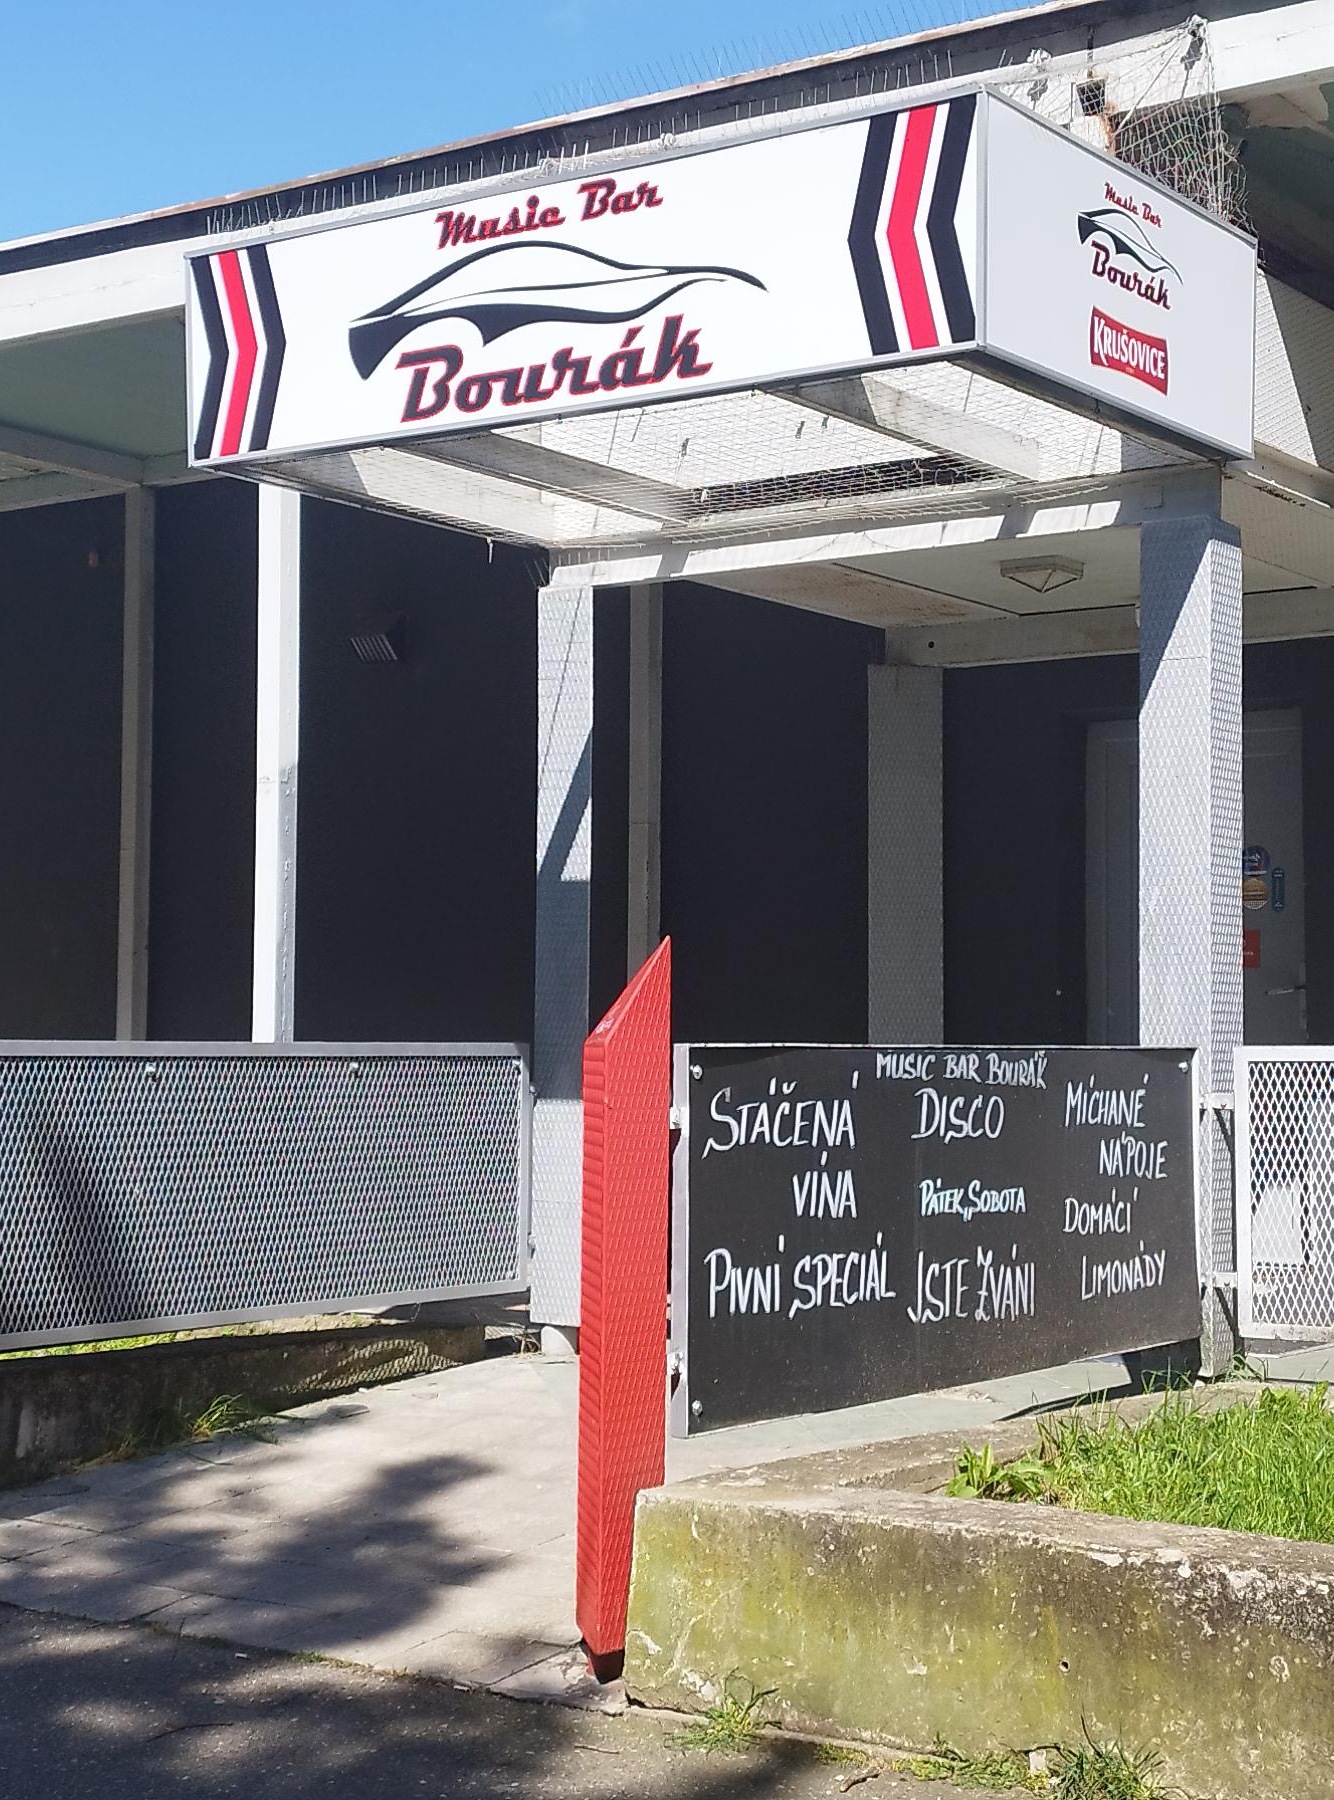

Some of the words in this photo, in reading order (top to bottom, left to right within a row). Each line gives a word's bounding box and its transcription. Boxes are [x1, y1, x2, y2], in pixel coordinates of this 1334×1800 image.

[434, 194, 566, 250] Music
[577, 177, 664, 221] Bar
[1104, 181, 1139, 216] Music
[1141, 202, 1163, 229] Bar
[1091, 239, 1172, 311] Bourák
[395, 313, 713, 423] Bourák
[876, 1052, 936, 1082] MUSIC
[942, 1053, 982, 1083] BAR
[1064, 1072, 1150, 1128] MÍCHANÉ
[701, 1069, 860, 1160] STÁČENÁ
[910, 1087, 1005, 1145] DISCO
[792, 1150, 858, 1220] VÍNA
[1098, 1130, 1169, 1180] NÁPOJE
[1062, 1186, 1139, 1236] DOMÁCÍ
[703, 1233, 786, 1319] PIVNÍ
[787, 1230, 897, 1320] SPECIÁL
[906, 1250, 971, 1325] JSTE
[1081, 1239, 1166, 1301] LIMONÁDY
